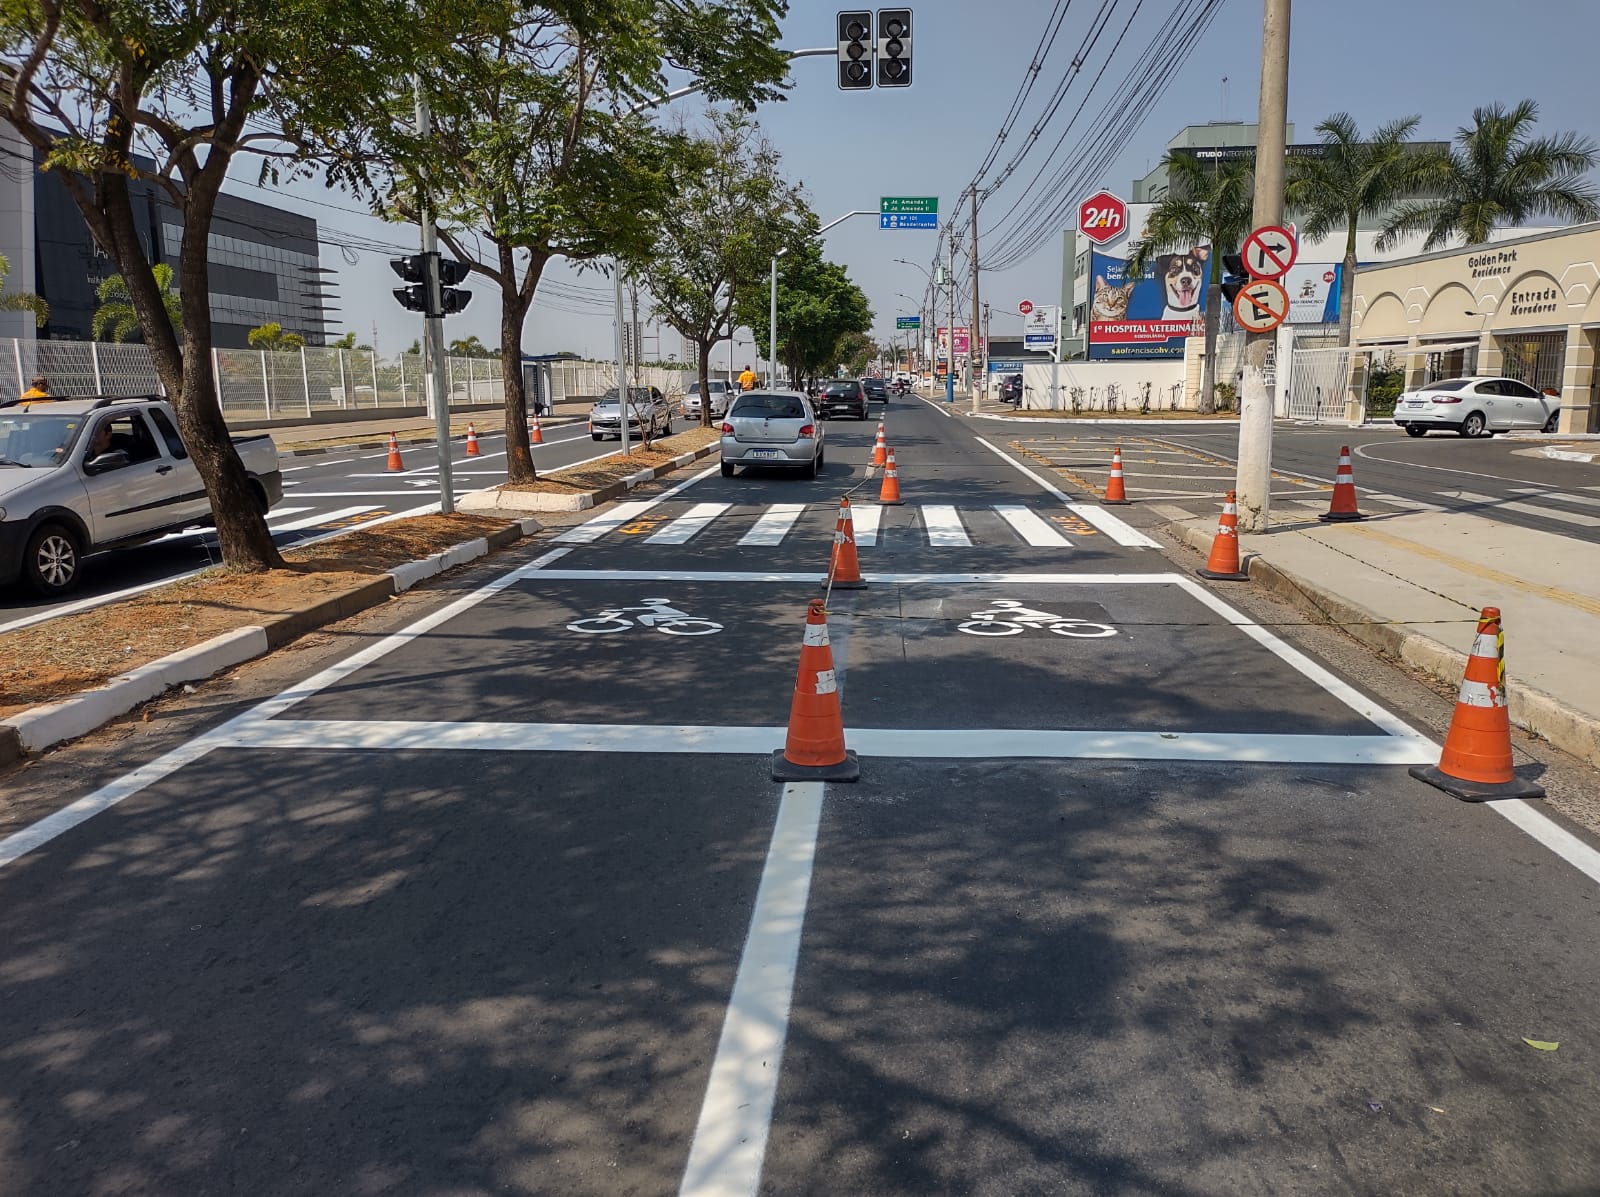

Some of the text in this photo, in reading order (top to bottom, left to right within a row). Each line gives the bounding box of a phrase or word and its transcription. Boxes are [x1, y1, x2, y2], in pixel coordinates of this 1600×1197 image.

[1084, 207, 1121, 228] 24h
[1468, 249, 1517, 268] Golden Park
[1471, 266, 1511, 278] Residence
[1512, 287, 1557, 304] Entrada
[1510, 303, 1557, 316] Moradores
[1104, 324, 1148, 334] HOSPITAL
